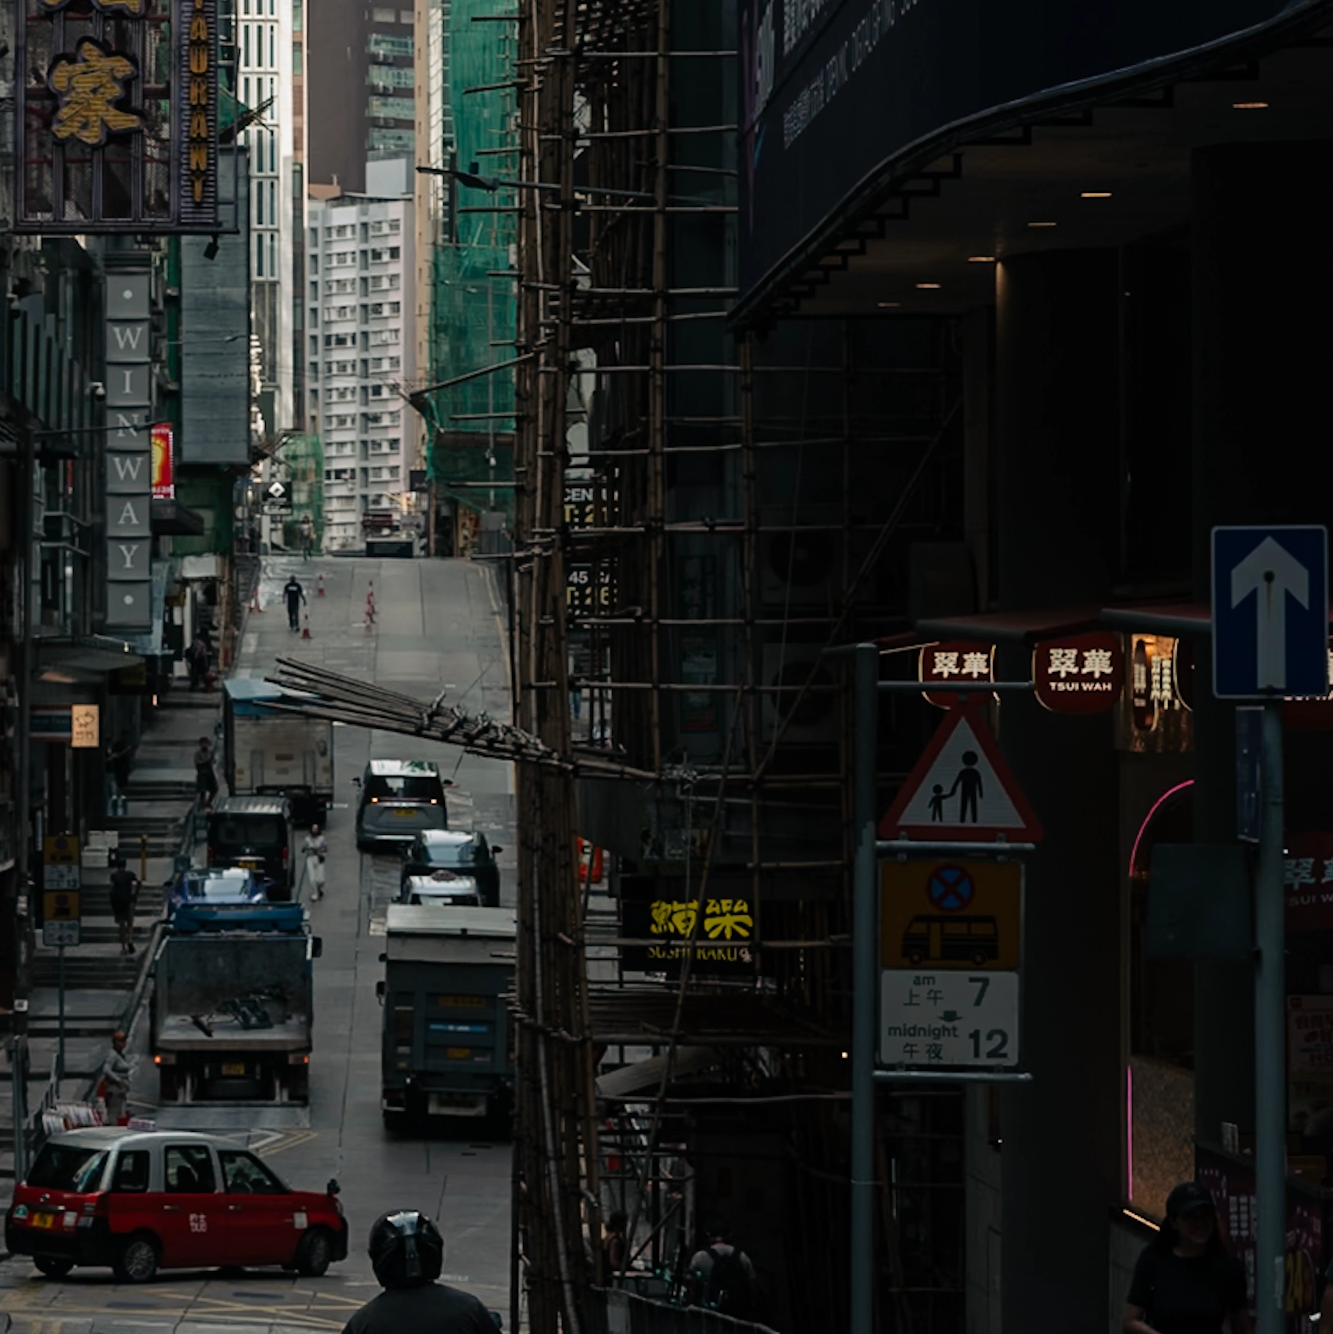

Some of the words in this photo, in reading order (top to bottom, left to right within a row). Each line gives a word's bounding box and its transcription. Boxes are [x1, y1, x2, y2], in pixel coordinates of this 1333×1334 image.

[931, 651, 991, 680] 翠華
[1047, 647, 1114, 680] 翠華
[1049, 681, 1080, 692] TSUI
[1080, 681, 1113, 693] WAH
[913, 976, 935, 986] am
[903, 988, 944, 1007] 上午
[969, 977, 990, 1007] 7
[888, 1023, 958, 1040] midnight
[903, 1042, 943, 1060] 午夜
[969, 1029, 1008, 1058] 12
